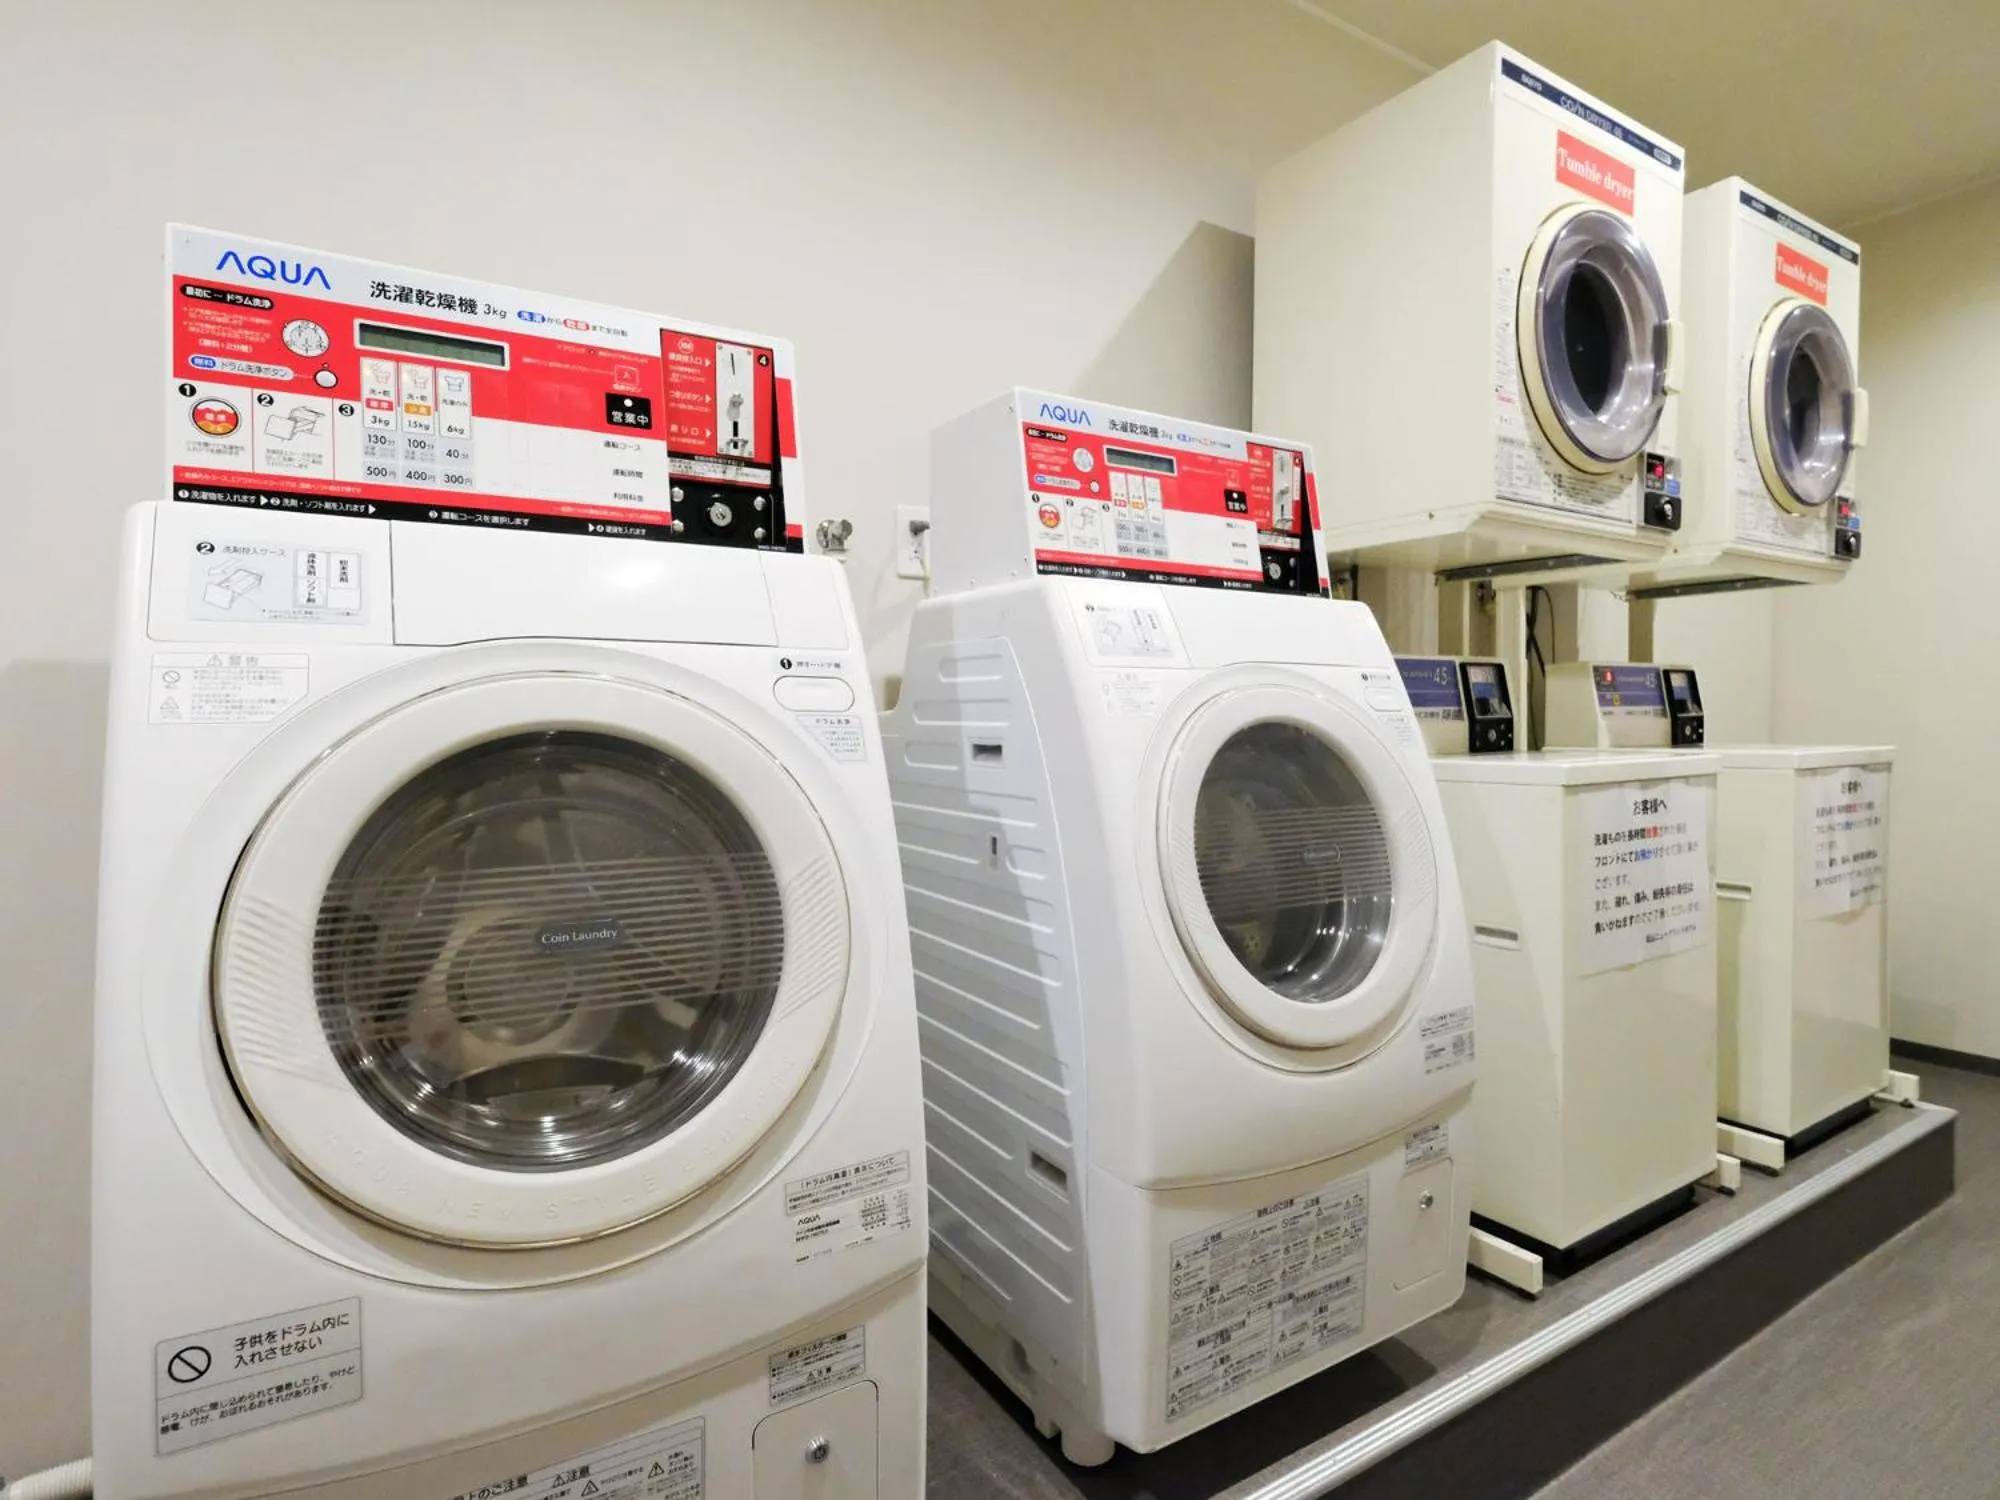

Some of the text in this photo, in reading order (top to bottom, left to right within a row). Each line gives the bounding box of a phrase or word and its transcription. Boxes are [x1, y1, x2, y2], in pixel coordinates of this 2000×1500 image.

[1603, 171, 1635, 201] dryer
[216, 250, 332, 291] AQUA
[369, 280, 479, 316] 洗濯乾燥機
[483, 303, 508, 319] 3kg
[370, 415, 391, 427] 3kg
[611, 410, 649, 426] 営業中
[1040, 403, 1092, 426] AQUA
[447, 424, 465, 435] 6kg
[190, 489, 256, 505] 洗濯物を入れます
[1632, 797, 1669, 816] お客様へ
[541, 928, 618, 945] Coin Laundry
[797, 1214, 821, 1226] AQUA
[233, 1312, 350, 1352] 子供をドラム内に
[233, 1336, 323, 1370] 入れさせない
